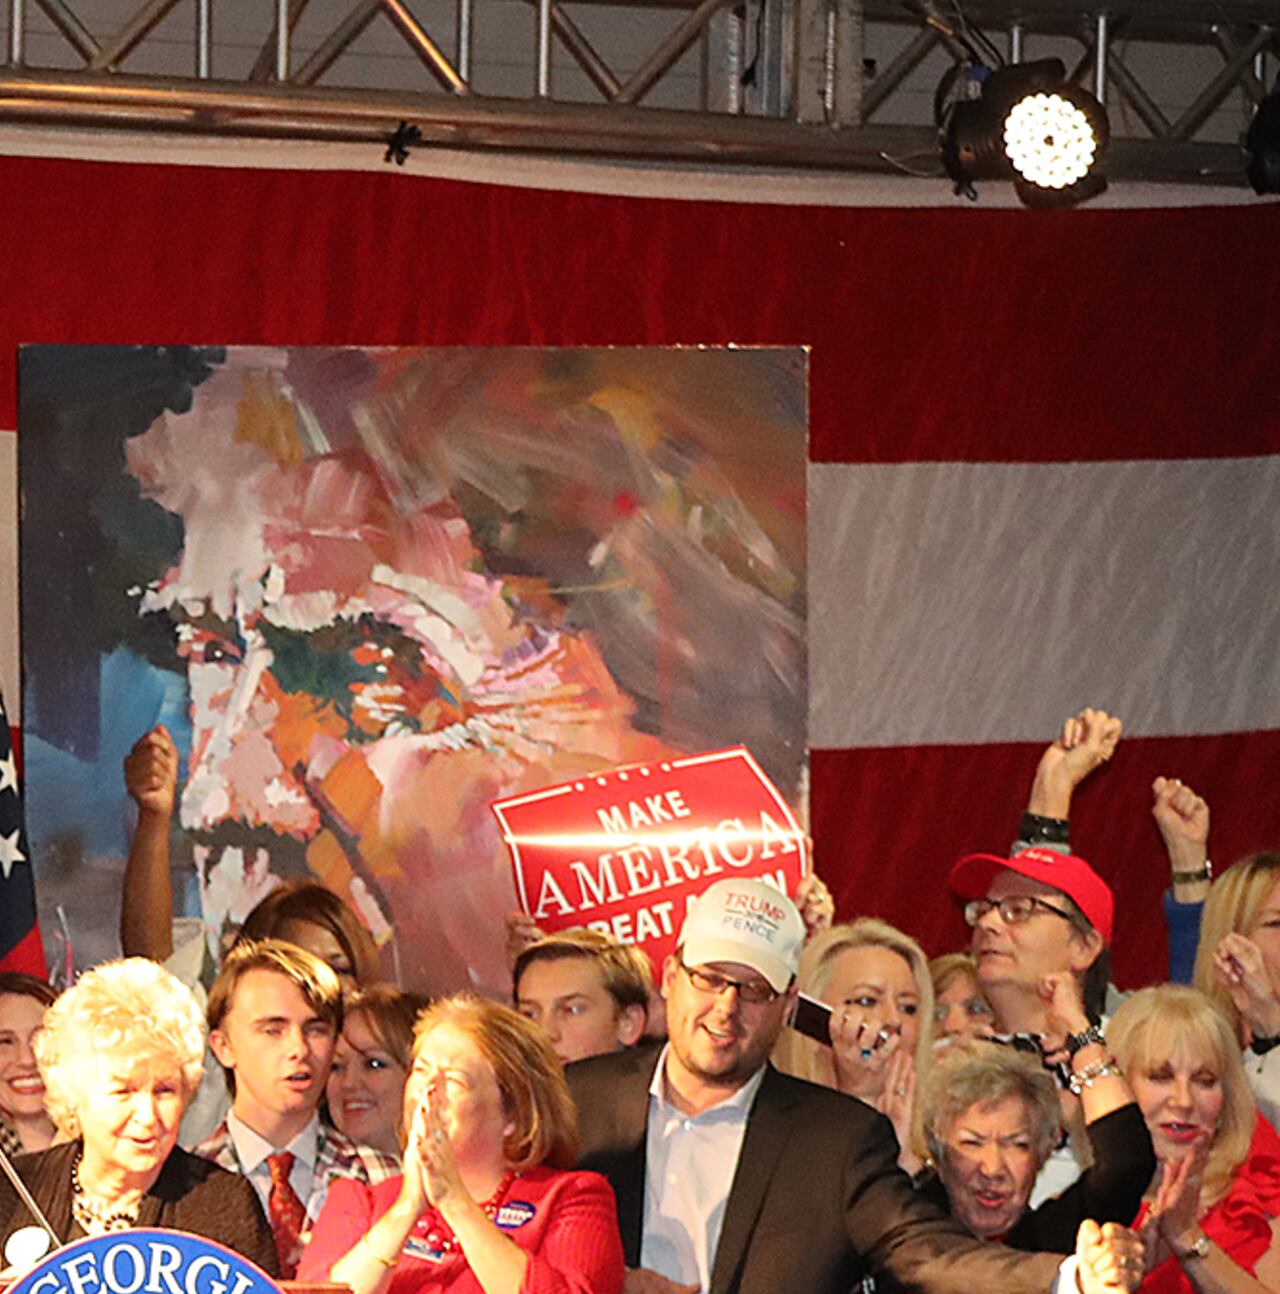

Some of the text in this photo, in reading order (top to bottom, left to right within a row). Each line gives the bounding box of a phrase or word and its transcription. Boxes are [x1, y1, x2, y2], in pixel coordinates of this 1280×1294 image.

[597, 791, 690, 834] MAKE
[535, 810, 797, 919] AMERICA
[566, 902, 674, 944] EAT
[725, 892, 786, 922] TRUMP
[722, 914, 778, 943] PENCE
